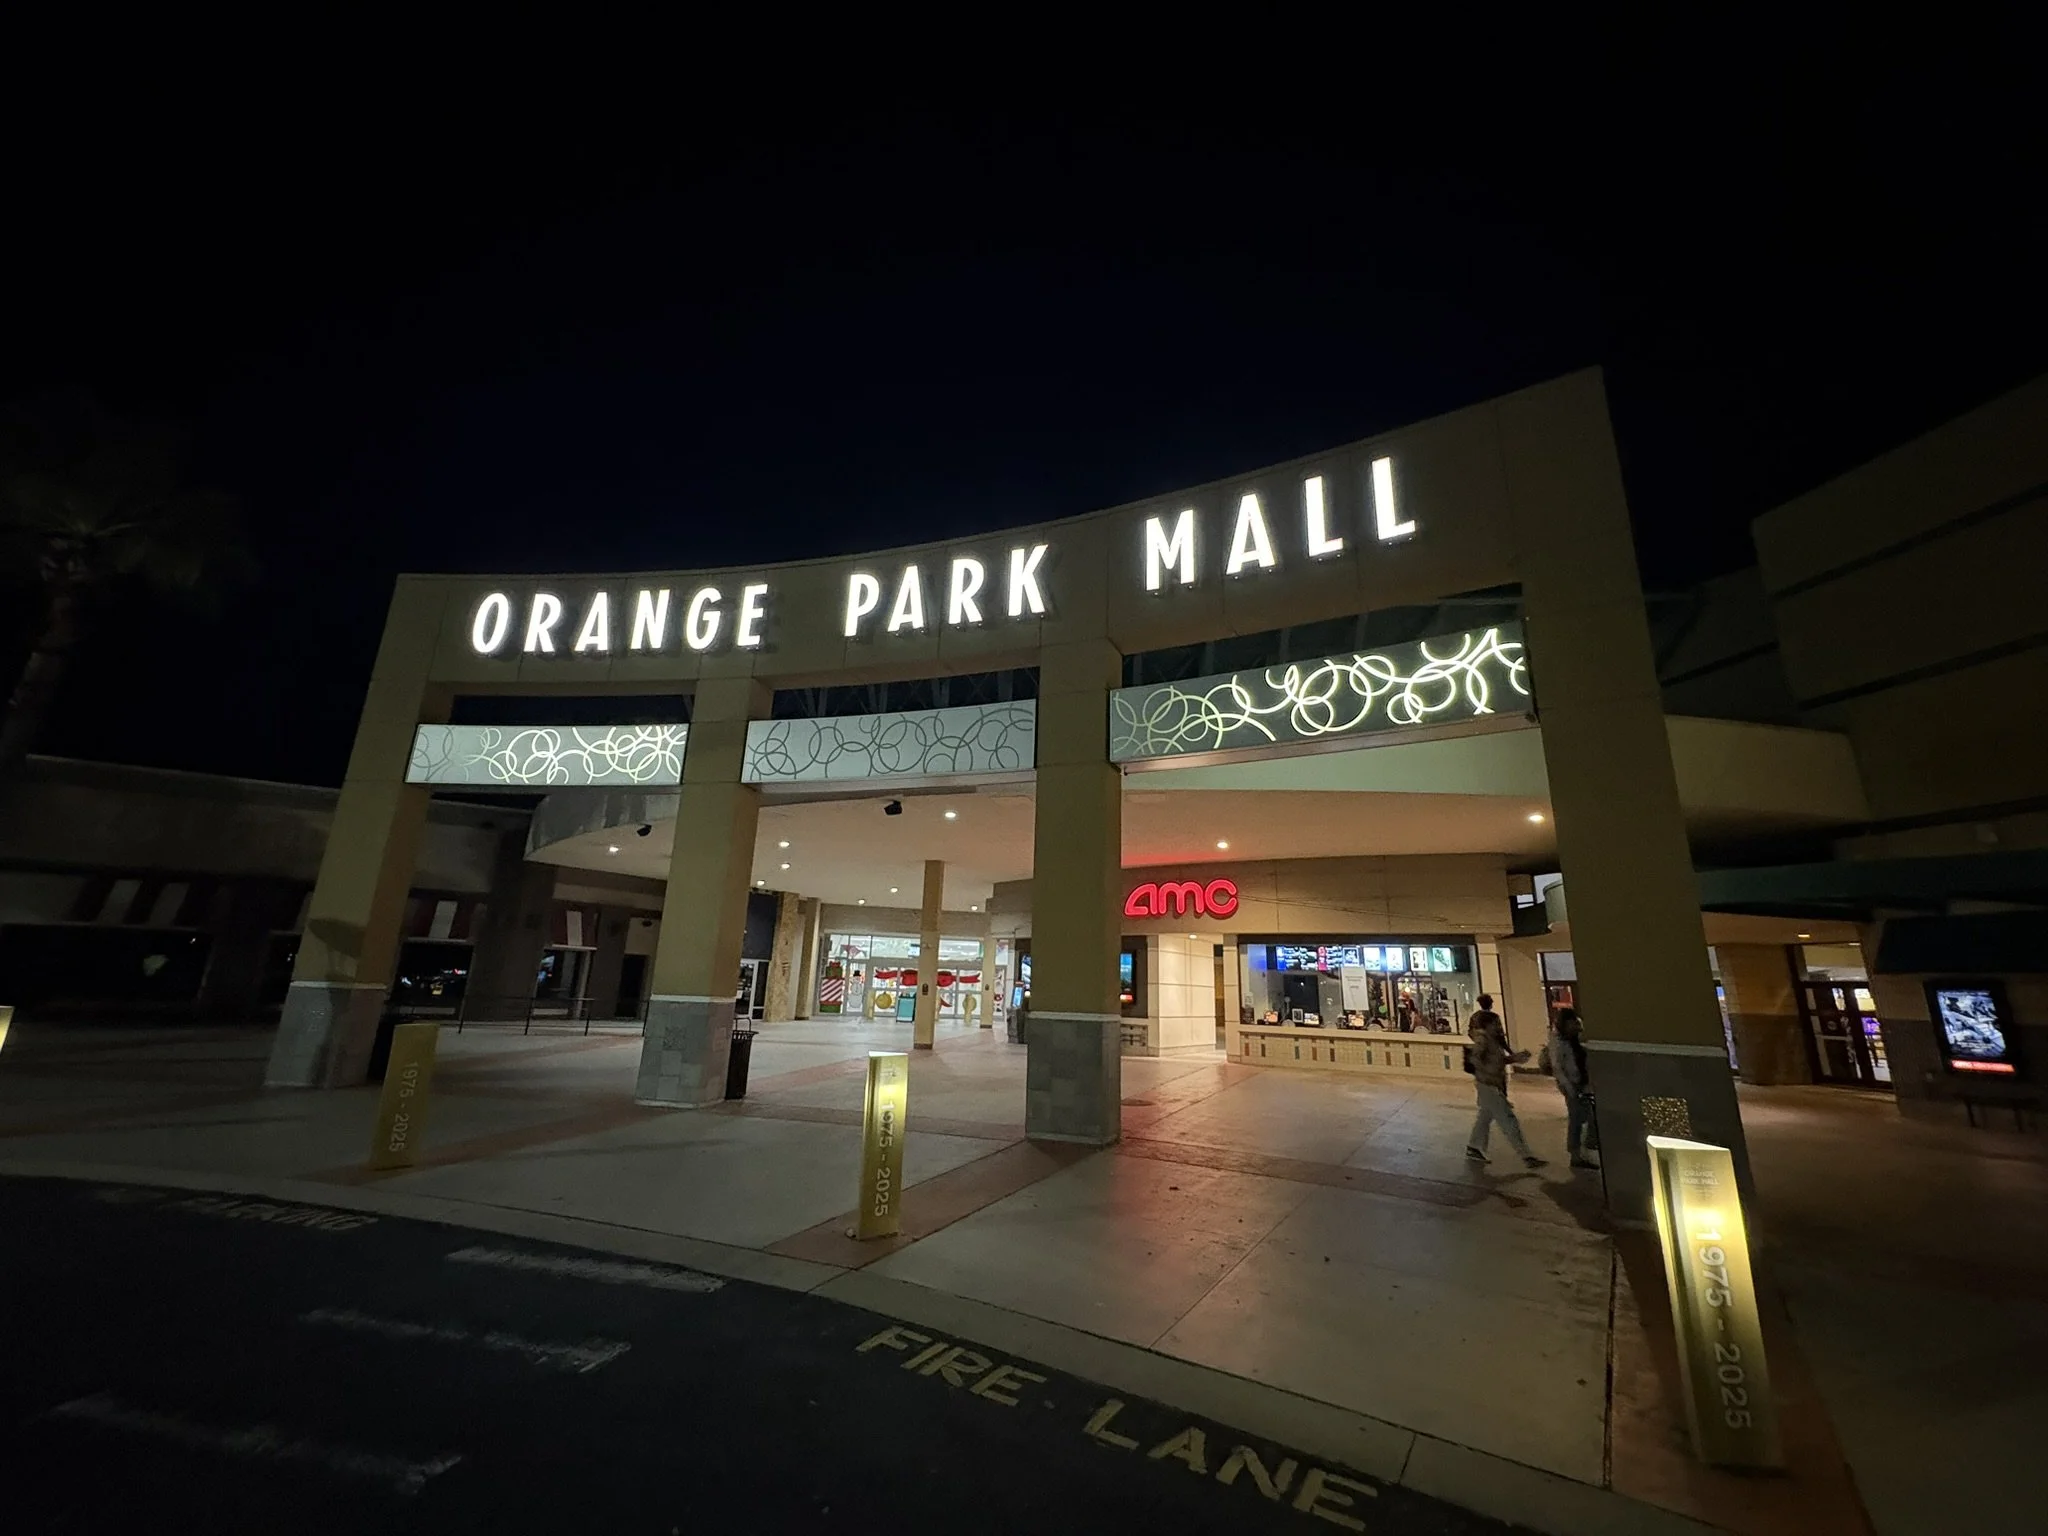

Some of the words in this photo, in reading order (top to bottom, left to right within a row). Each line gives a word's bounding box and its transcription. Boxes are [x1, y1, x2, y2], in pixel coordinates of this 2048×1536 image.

[472, 583, 769, 654] ORANGE
[844, 544, 1049, 637] PARK
[1145, 456, 1416, 591] MALL
[400, 1061, 419, 1098] 1975
[389, 1113, 410, 1152] 2025
[879, 1101, 894, 1148] 1975
[875, 1167, 891, 1217] 2025
[1696, 1227, 1732, 1309] 1975
[1713, 1342, 1750, 1429] 2025
[854, 1324, 1048, 1407] FIRE
[1082, 1399, 1379, 1532] LANE
